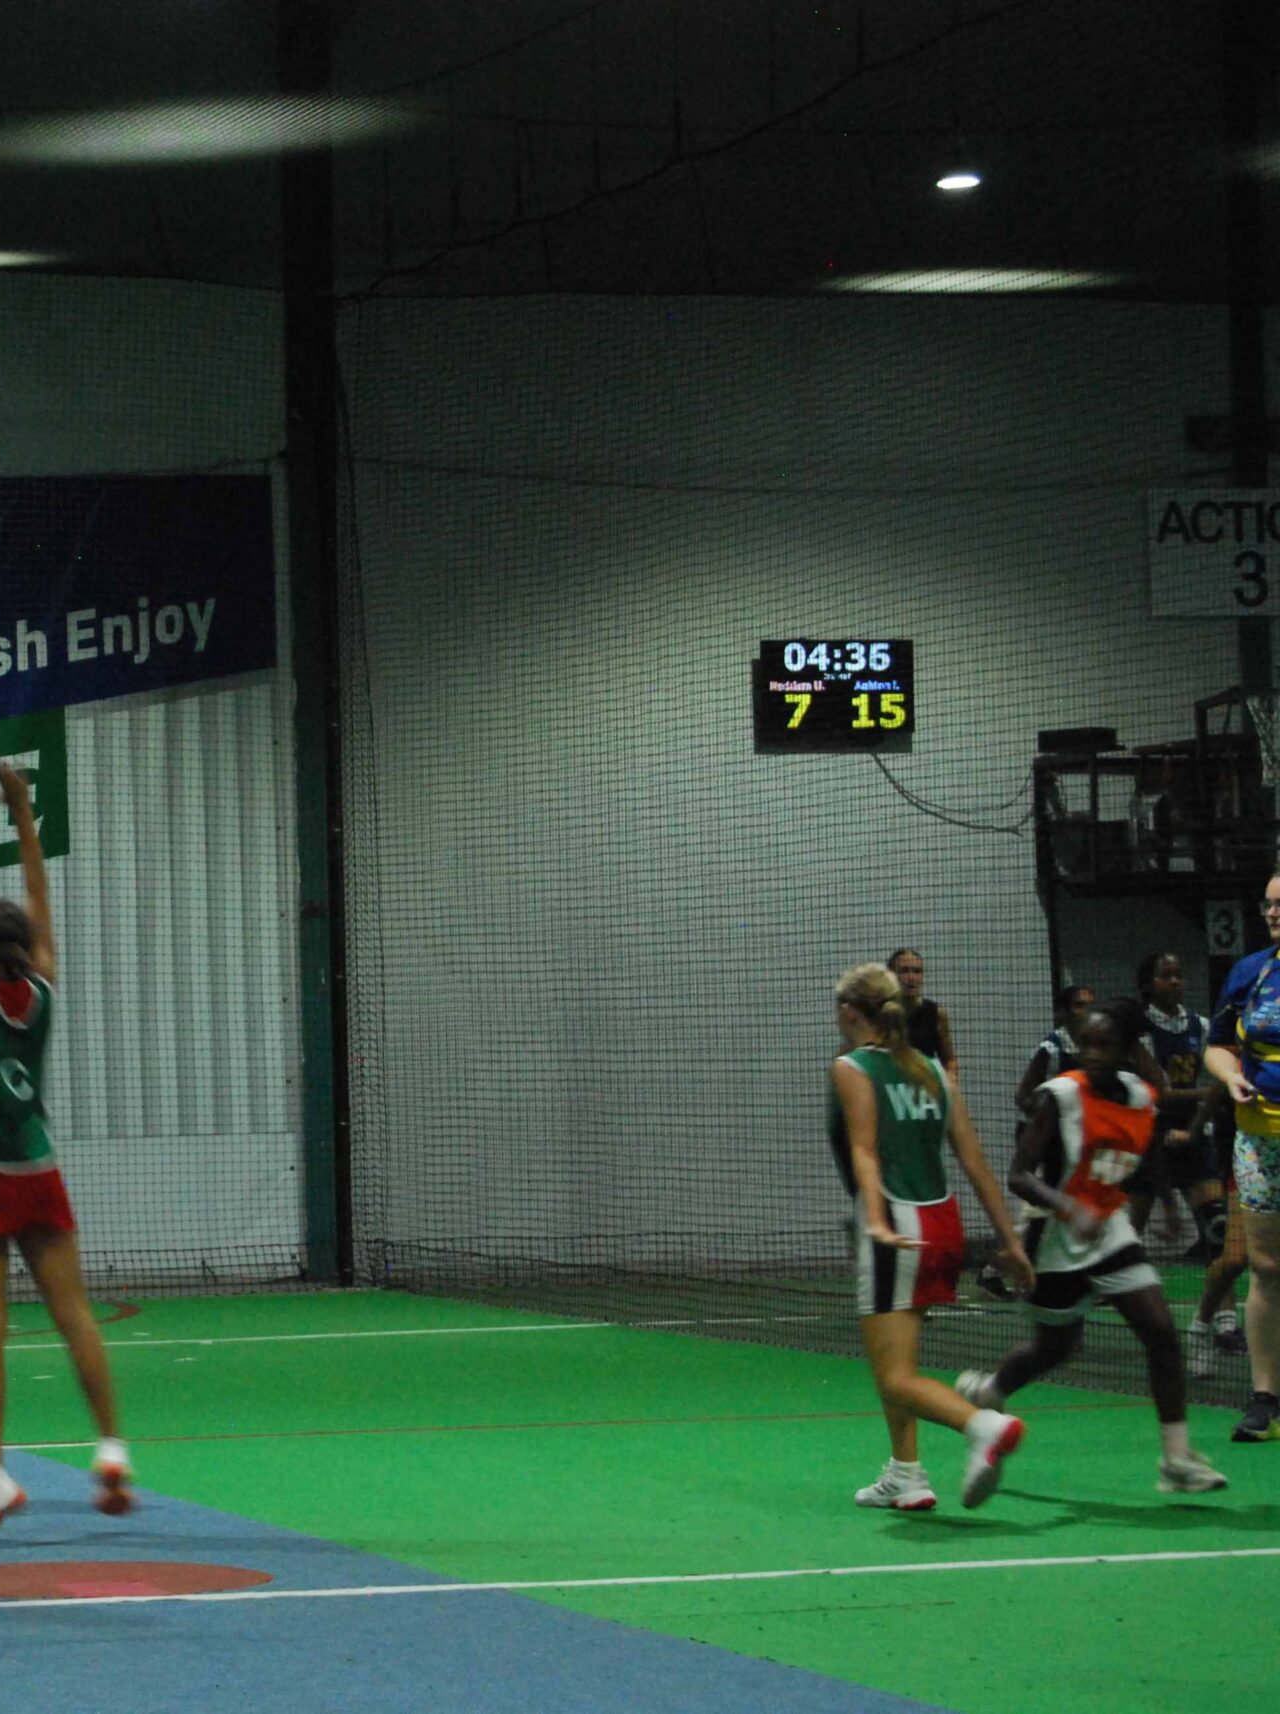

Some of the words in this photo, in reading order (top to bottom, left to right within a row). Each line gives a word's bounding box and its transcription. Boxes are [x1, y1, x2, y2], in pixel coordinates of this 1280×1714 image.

[1157, 501, 1280, 544] ACTI
[1233, 551, 1268, 607] 3
[66, 597, 217, 665] Enjoy
[784, 693, 812, 729] 7
[851, 693, 907, 729] 15
[1214, 910, 1237, 949] 3
[884, 1083, 941, 1121] WA
